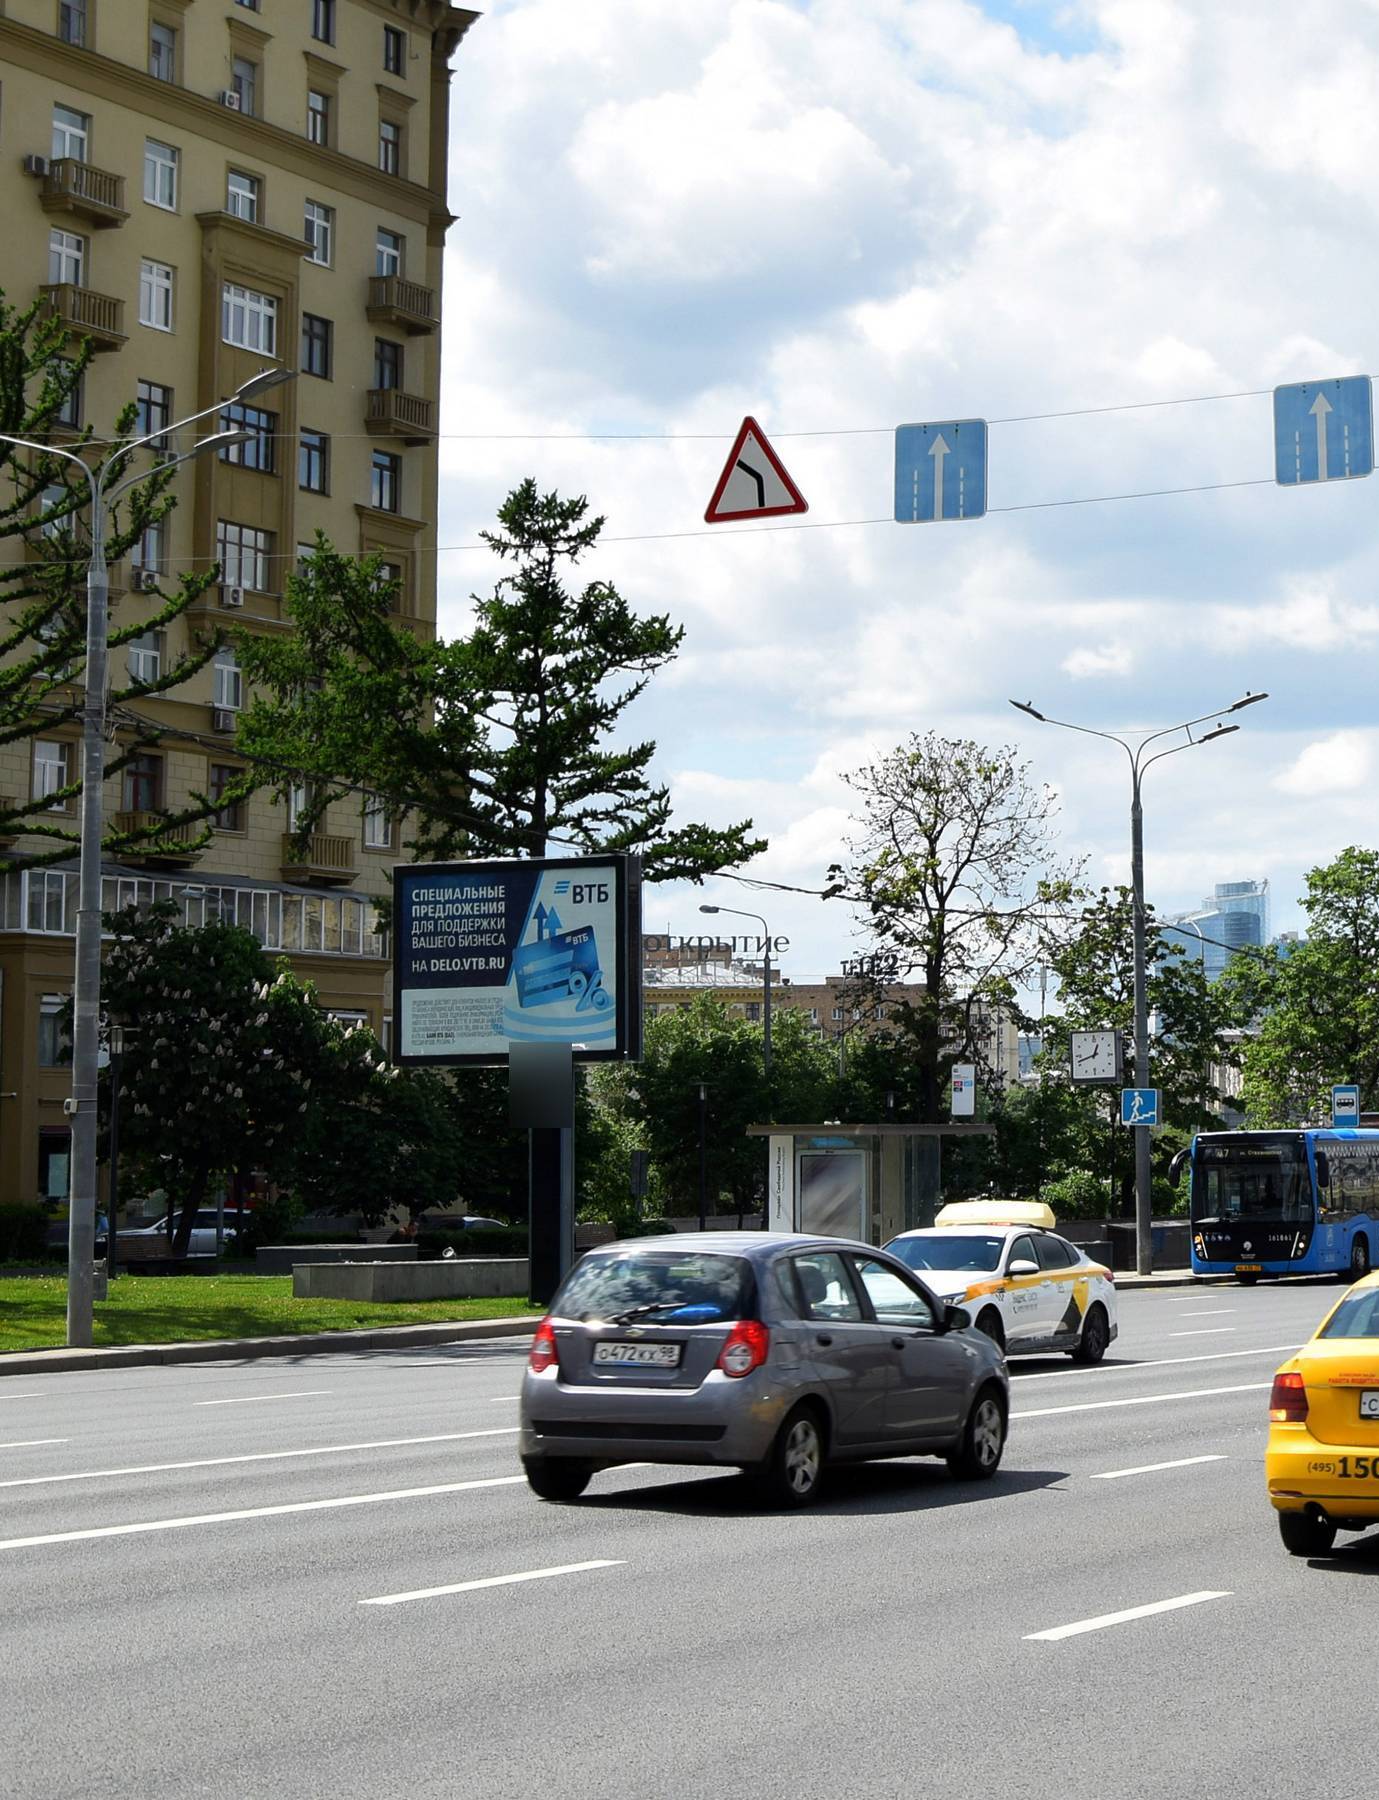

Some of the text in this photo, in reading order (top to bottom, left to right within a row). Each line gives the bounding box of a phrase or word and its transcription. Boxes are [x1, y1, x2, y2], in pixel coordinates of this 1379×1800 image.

[411, 885, 506, 902] СПЕЦИАЛЬНЫЕ
[572, 883, 609, 904] ВТБ
[411, 901, 506, 918] ПРЕДЛОЖЕНИЯ
[411, 917, 506, 935] ДЛЯ ПОДДЕРЖКИ
[411, 932, 506, 949] ВАШЕГО БИЗНЕСА
[572, 932, 589, 945] ВТБ
[643, 934, 790, 958] открытие
[411, 956, 505, 973] НА DELO.VTB.RU
[1307, 1461, 1336, 1475] (495)
